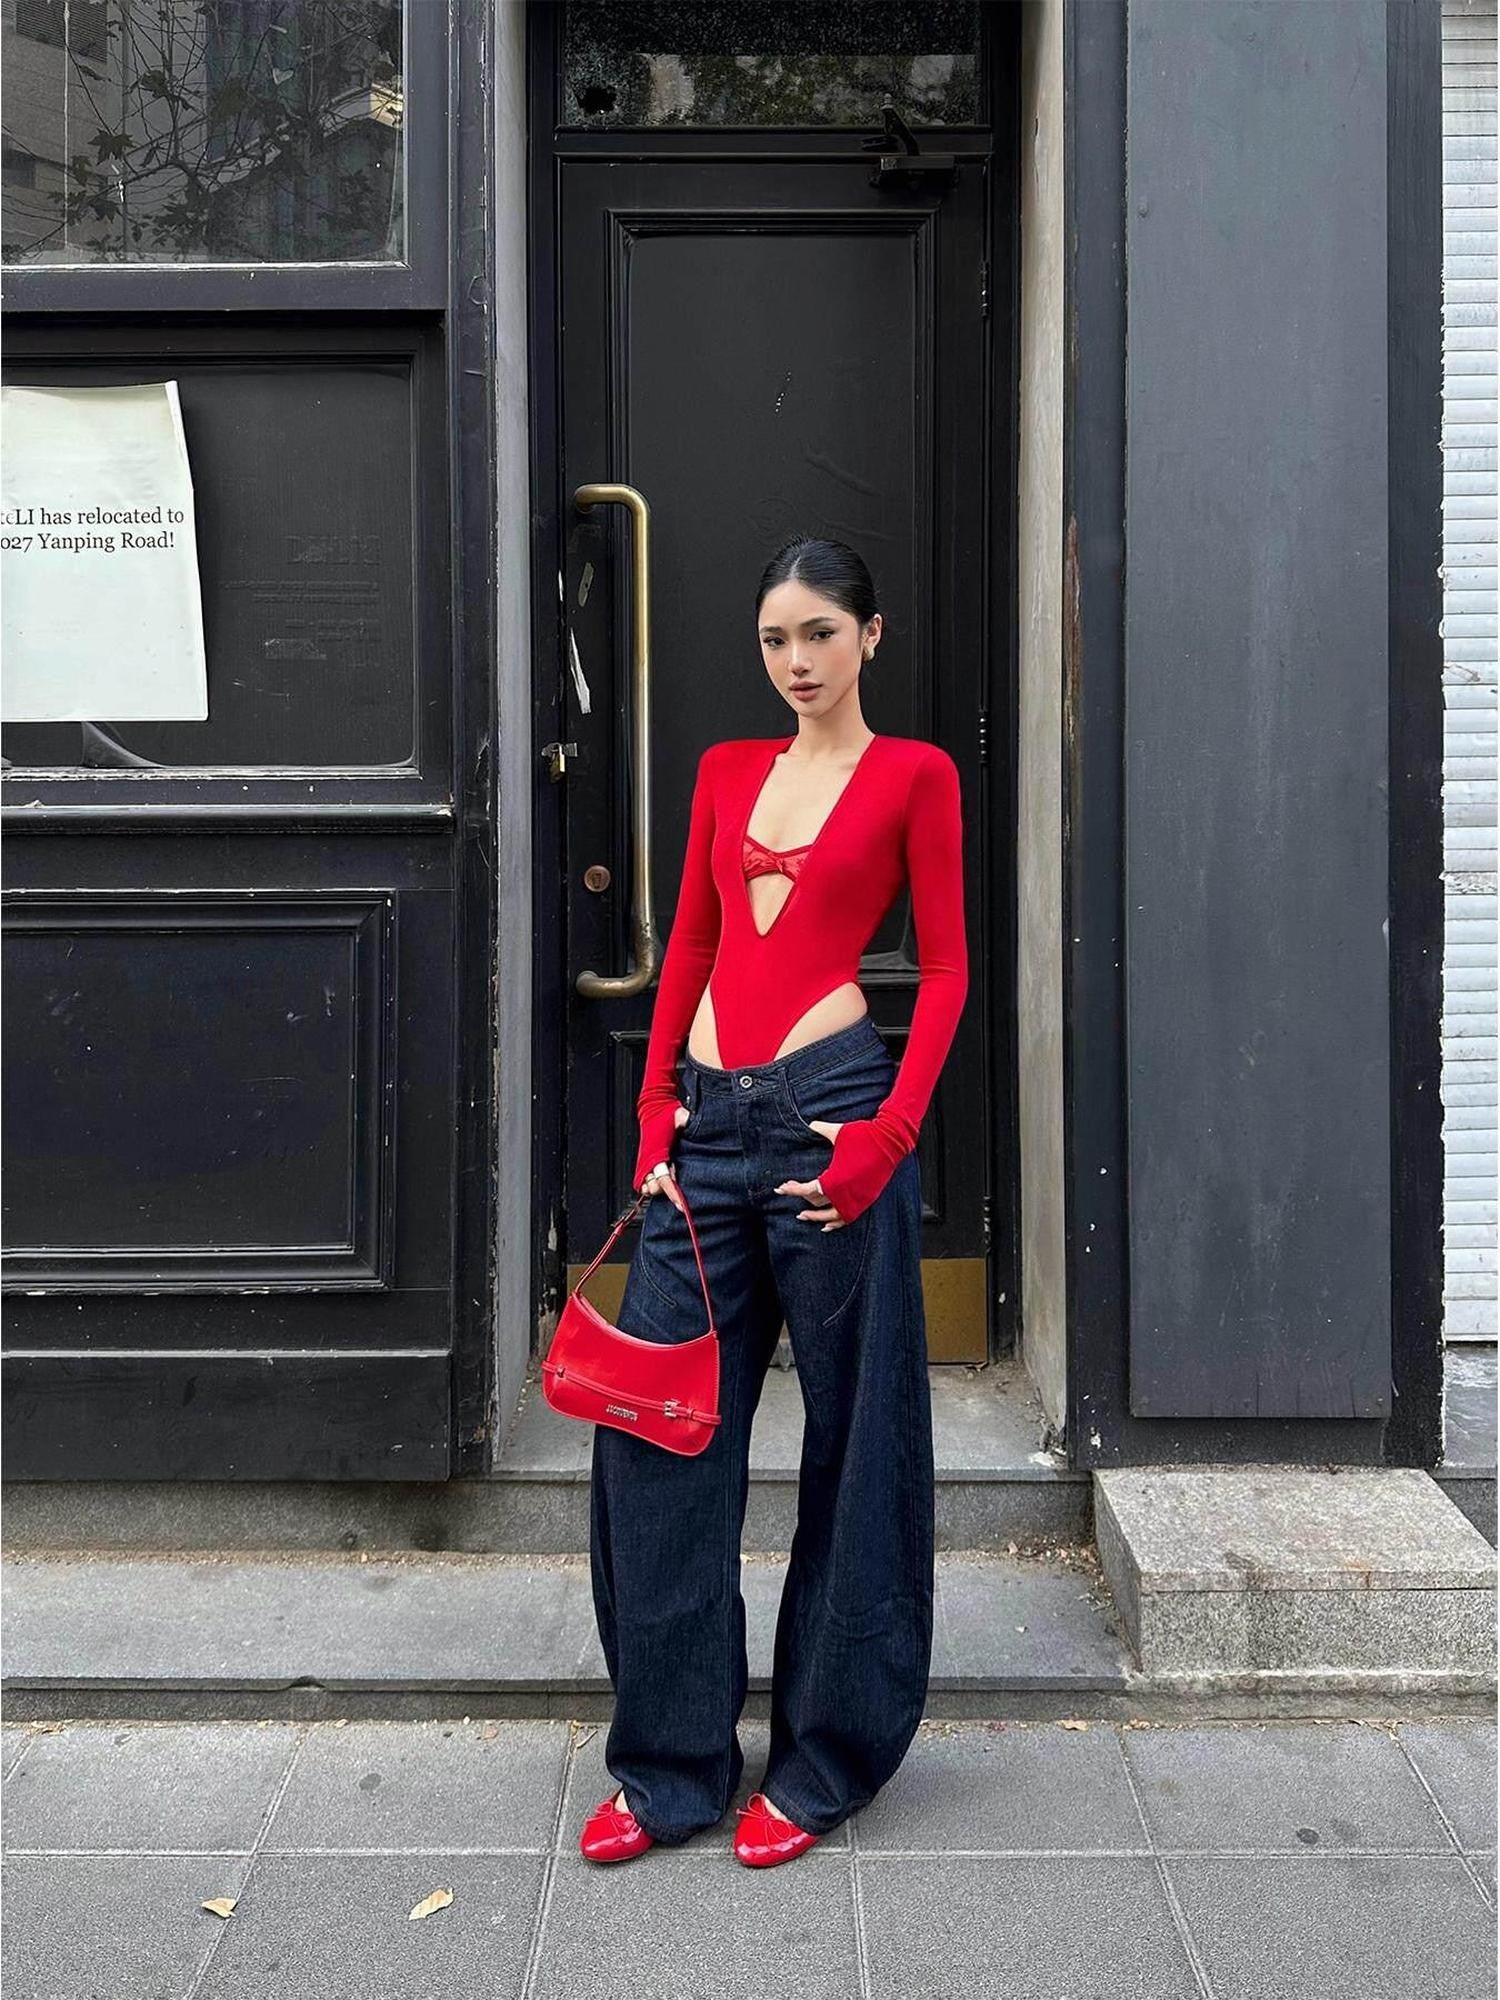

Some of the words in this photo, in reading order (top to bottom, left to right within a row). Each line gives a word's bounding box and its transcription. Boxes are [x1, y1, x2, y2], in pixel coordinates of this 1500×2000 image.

[39, 506, 72, 526] has
[77, 505, 163, 526] relocated
[166, 507, 185, 525] to
[37, 531, 116, 554] Yanping
[120, 530, 175, 550] Road!
